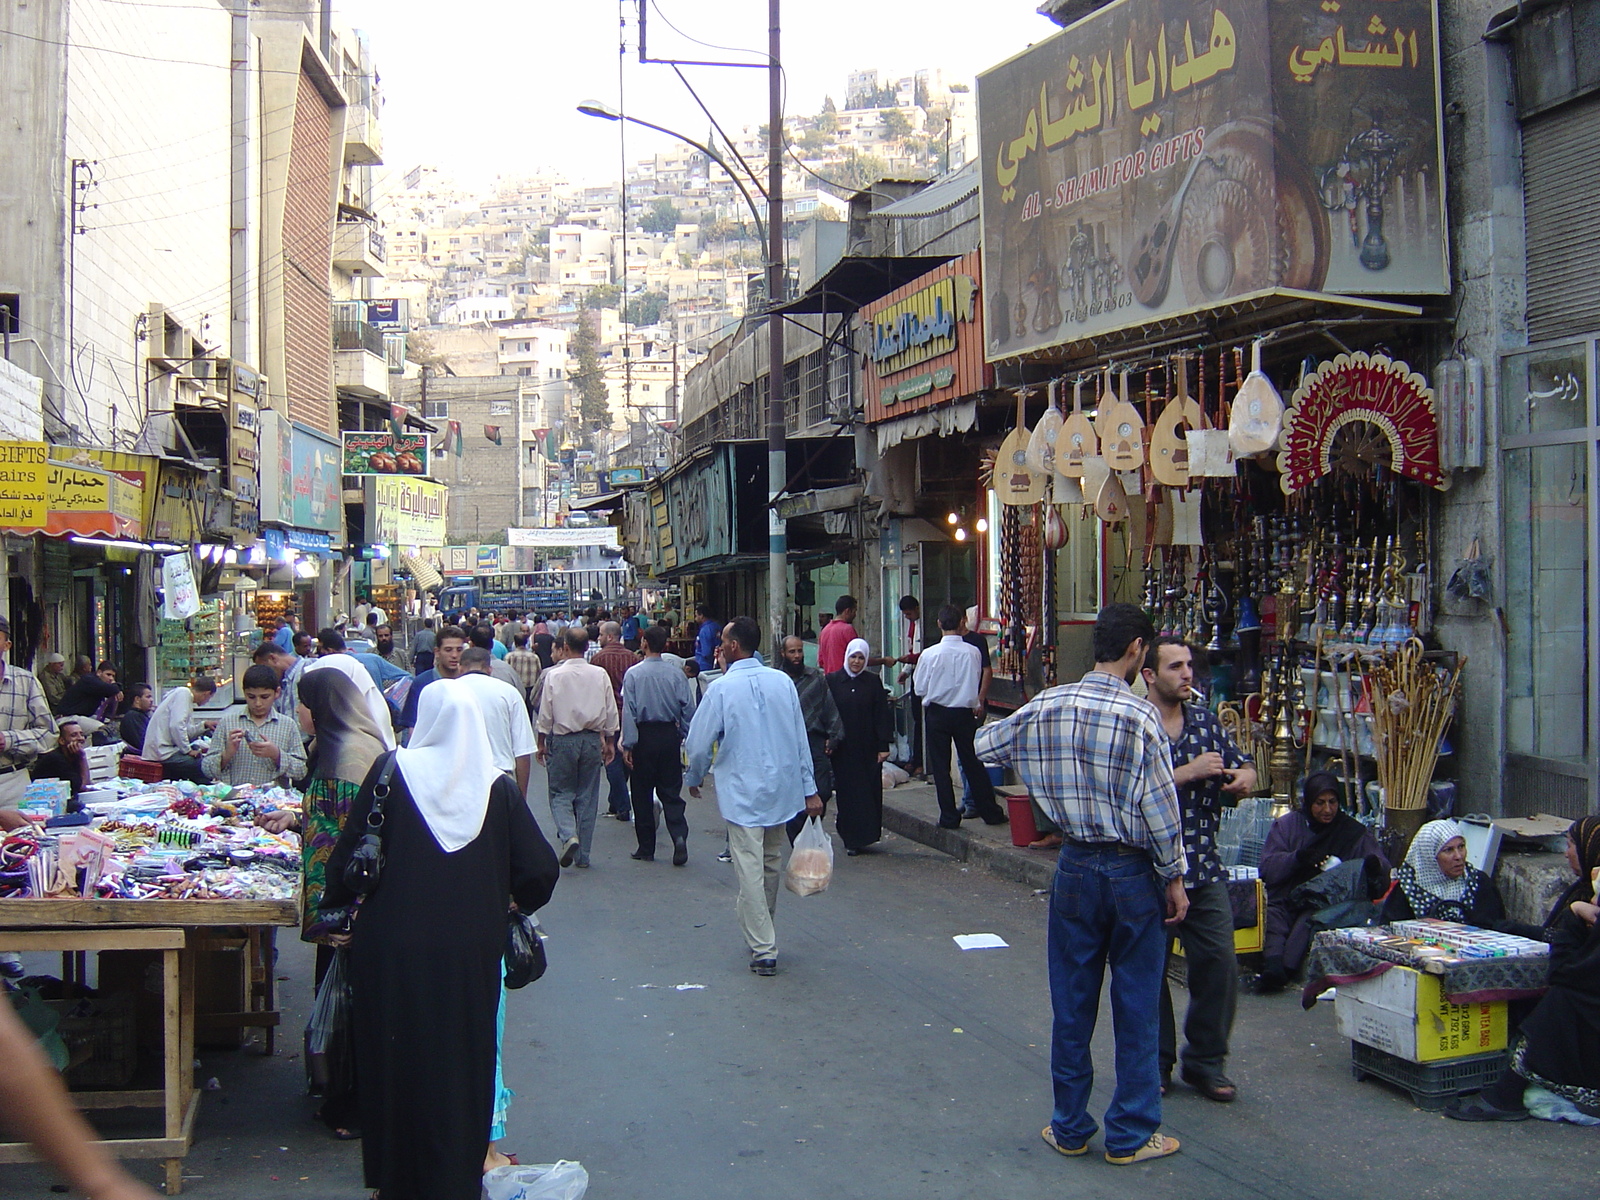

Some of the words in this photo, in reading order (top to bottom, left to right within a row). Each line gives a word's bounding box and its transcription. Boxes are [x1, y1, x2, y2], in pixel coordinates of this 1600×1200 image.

[1289, 14, 1418, 82] الشامي
[1140, 9, 1236, 137] هدايا
[996, 49, 1115, 204] الشامي
[1022, 191, 1042, 222] AL
[1055, 164, 1108, 209] SHAMI
[1111, 148, 1147, 188] FOR
[1149, 125, 1206, 173] GIFTS
[0, 489, 21, 500] تشك
[23, 492, 45, 502] توجد
[0, 507, 18, 518] الدا
[1480, 1016, 1490, 1029] TEA
[1439, 1036, 1449, 1051] KGS
[1450, 1034, 1460, 1050] KGS
[1480, 1030, 1490, 1047] BAGS
